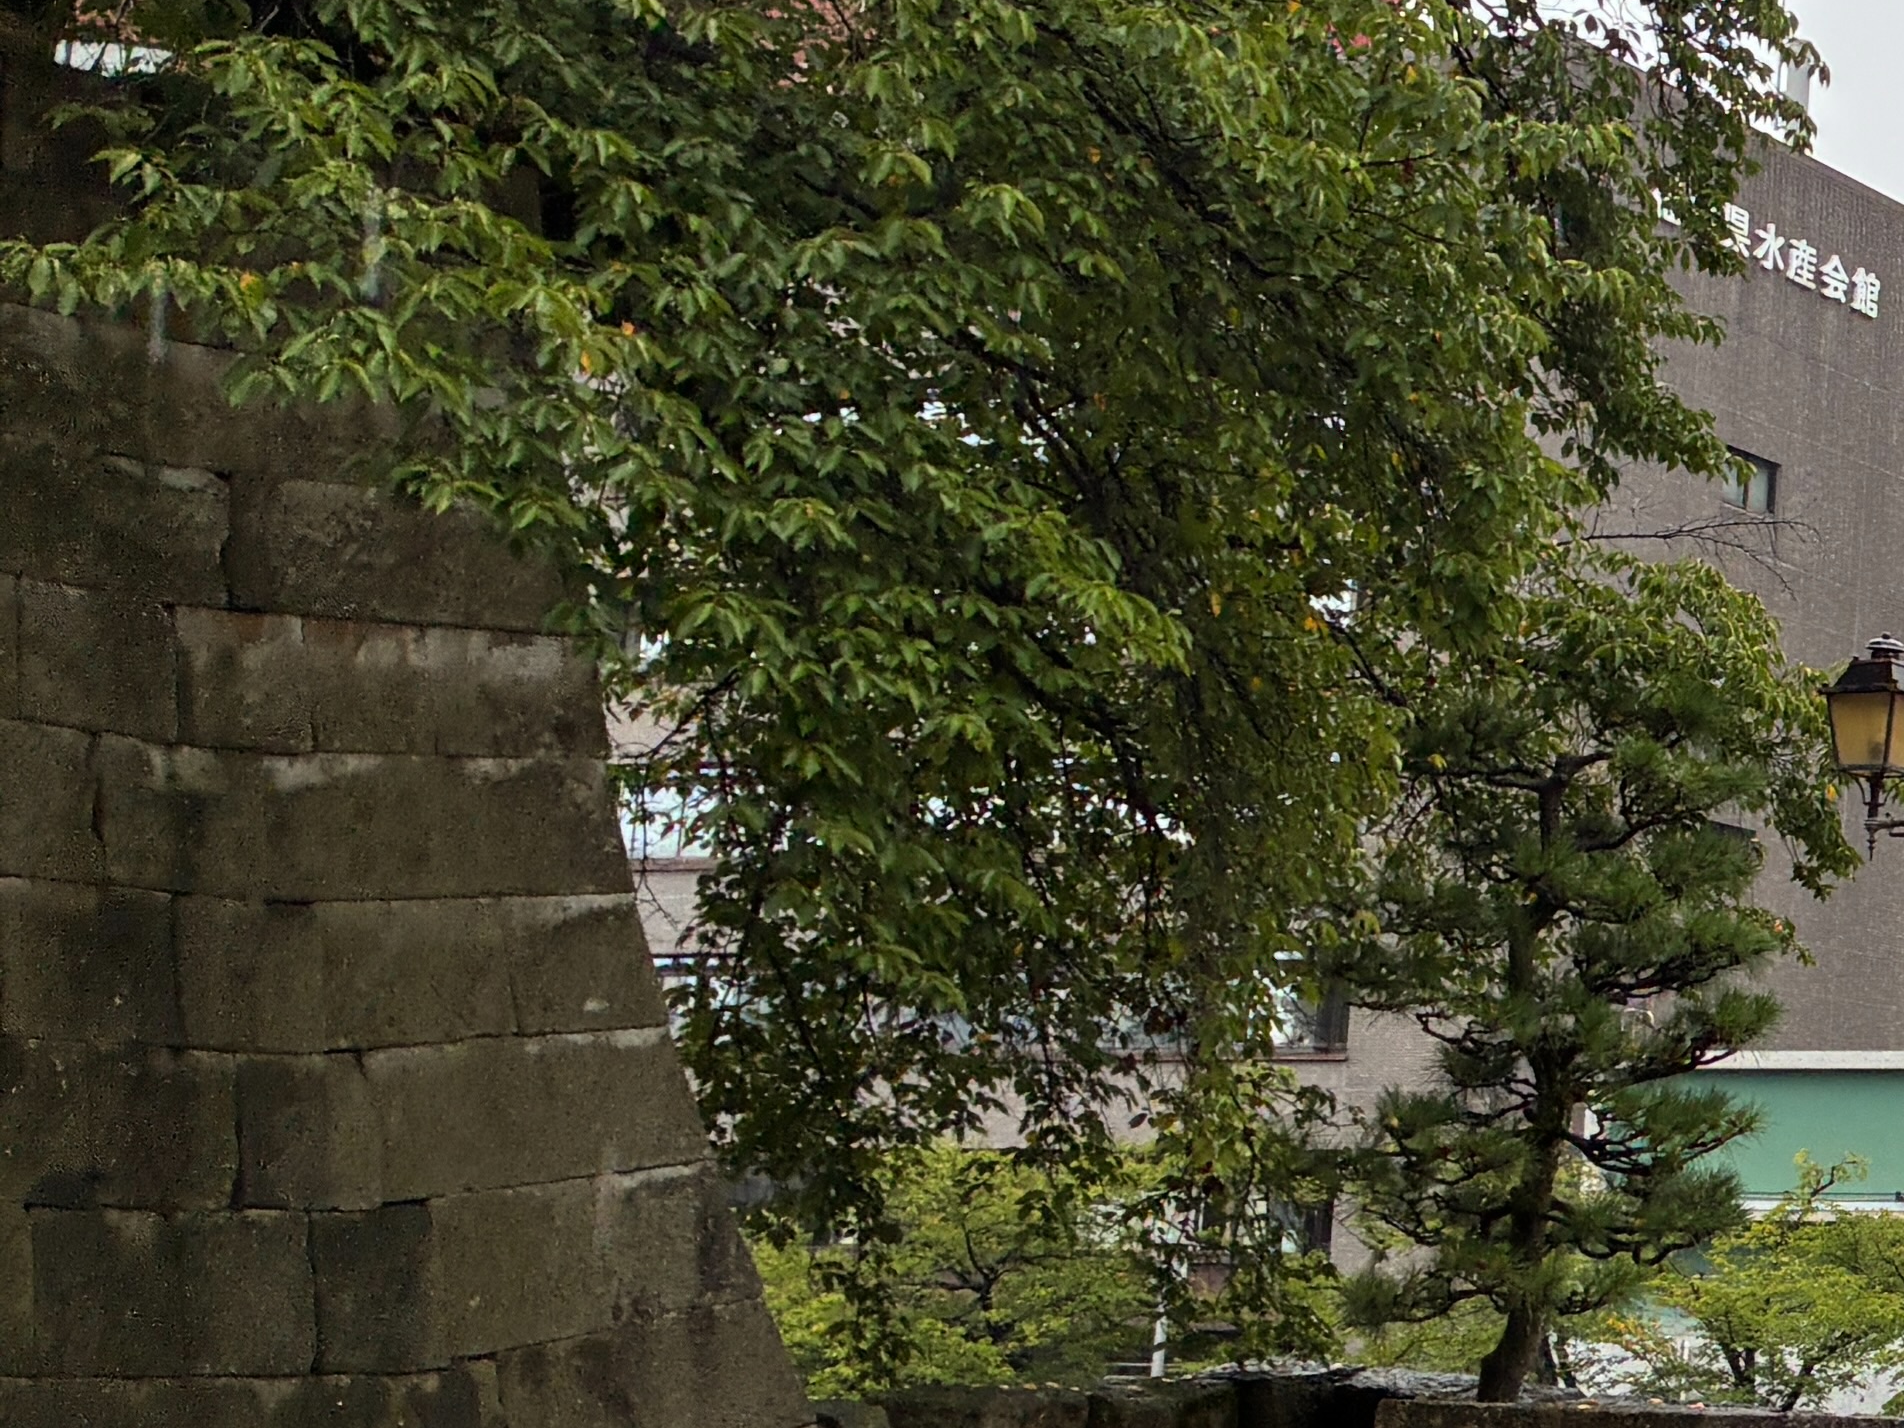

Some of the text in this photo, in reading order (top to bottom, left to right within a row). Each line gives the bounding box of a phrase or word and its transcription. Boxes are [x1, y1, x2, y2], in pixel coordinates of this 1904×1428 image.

[1651, 187, 1880, 318] 県水産会館
